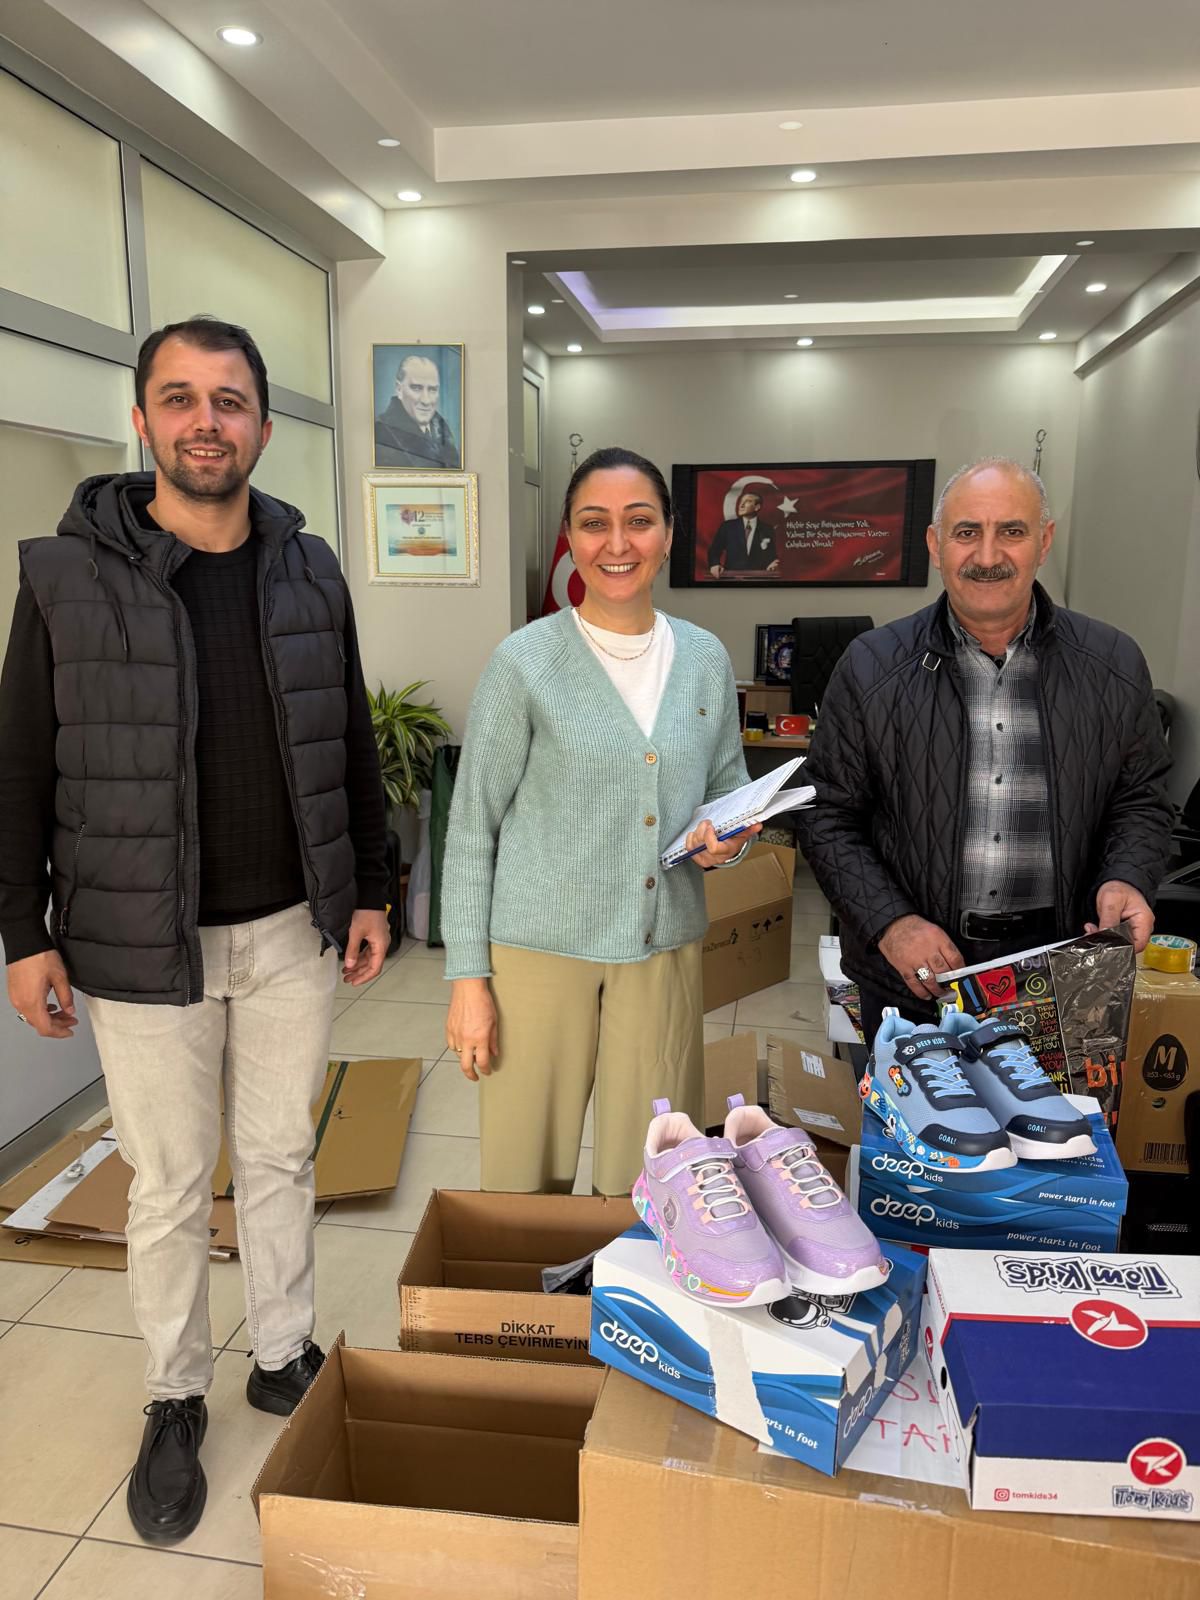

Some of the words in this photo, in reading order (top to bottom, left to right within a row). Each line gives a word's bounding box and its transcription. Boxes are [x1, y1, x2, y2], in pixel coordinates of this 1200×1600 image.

[992, 1025, 1007, 1033] DEEP
[915, 1039, 931, 1049] DEEP
[1153, 1045, 1178, 1070] M
[1027, 1123, 1047, 1134] GOAL!
[938, 1133, 957, 1145] GOAL!
[871, 1153, 924, 1179] deep
[924, 1171, 944, 1183] kids
[1038, 1191, 1063, 1201] power
[1064, 1194, 1087, 1204] starts
[1089, 1197, 1098, 1205] in
[1098, 1198, 1116, 1209] foot
[870, 1194, 936, 1226] deep
[936, 1217, 960, 1230] kids
[1006, 1231, 1037, 1243] power
[1038, 1237, 1066, 1248] starts
[1068, 1239, 1079, 1249] in
[1079, 1241, 1102, 1252] foot
[1005, 1258, 1088, 1291] Kids
[501, 1319, 555, 1336] DİKKAT
[455, 1332, 494, 1345] TERS
[599, 1320, 659, 1365] deep
[658, 1359, 682, 1380] kids
[784, 1423, 796, 1438] in
[796, 1431, 819, 1449] foot
[1012, 1490, 1058, 1501] tomkids34
